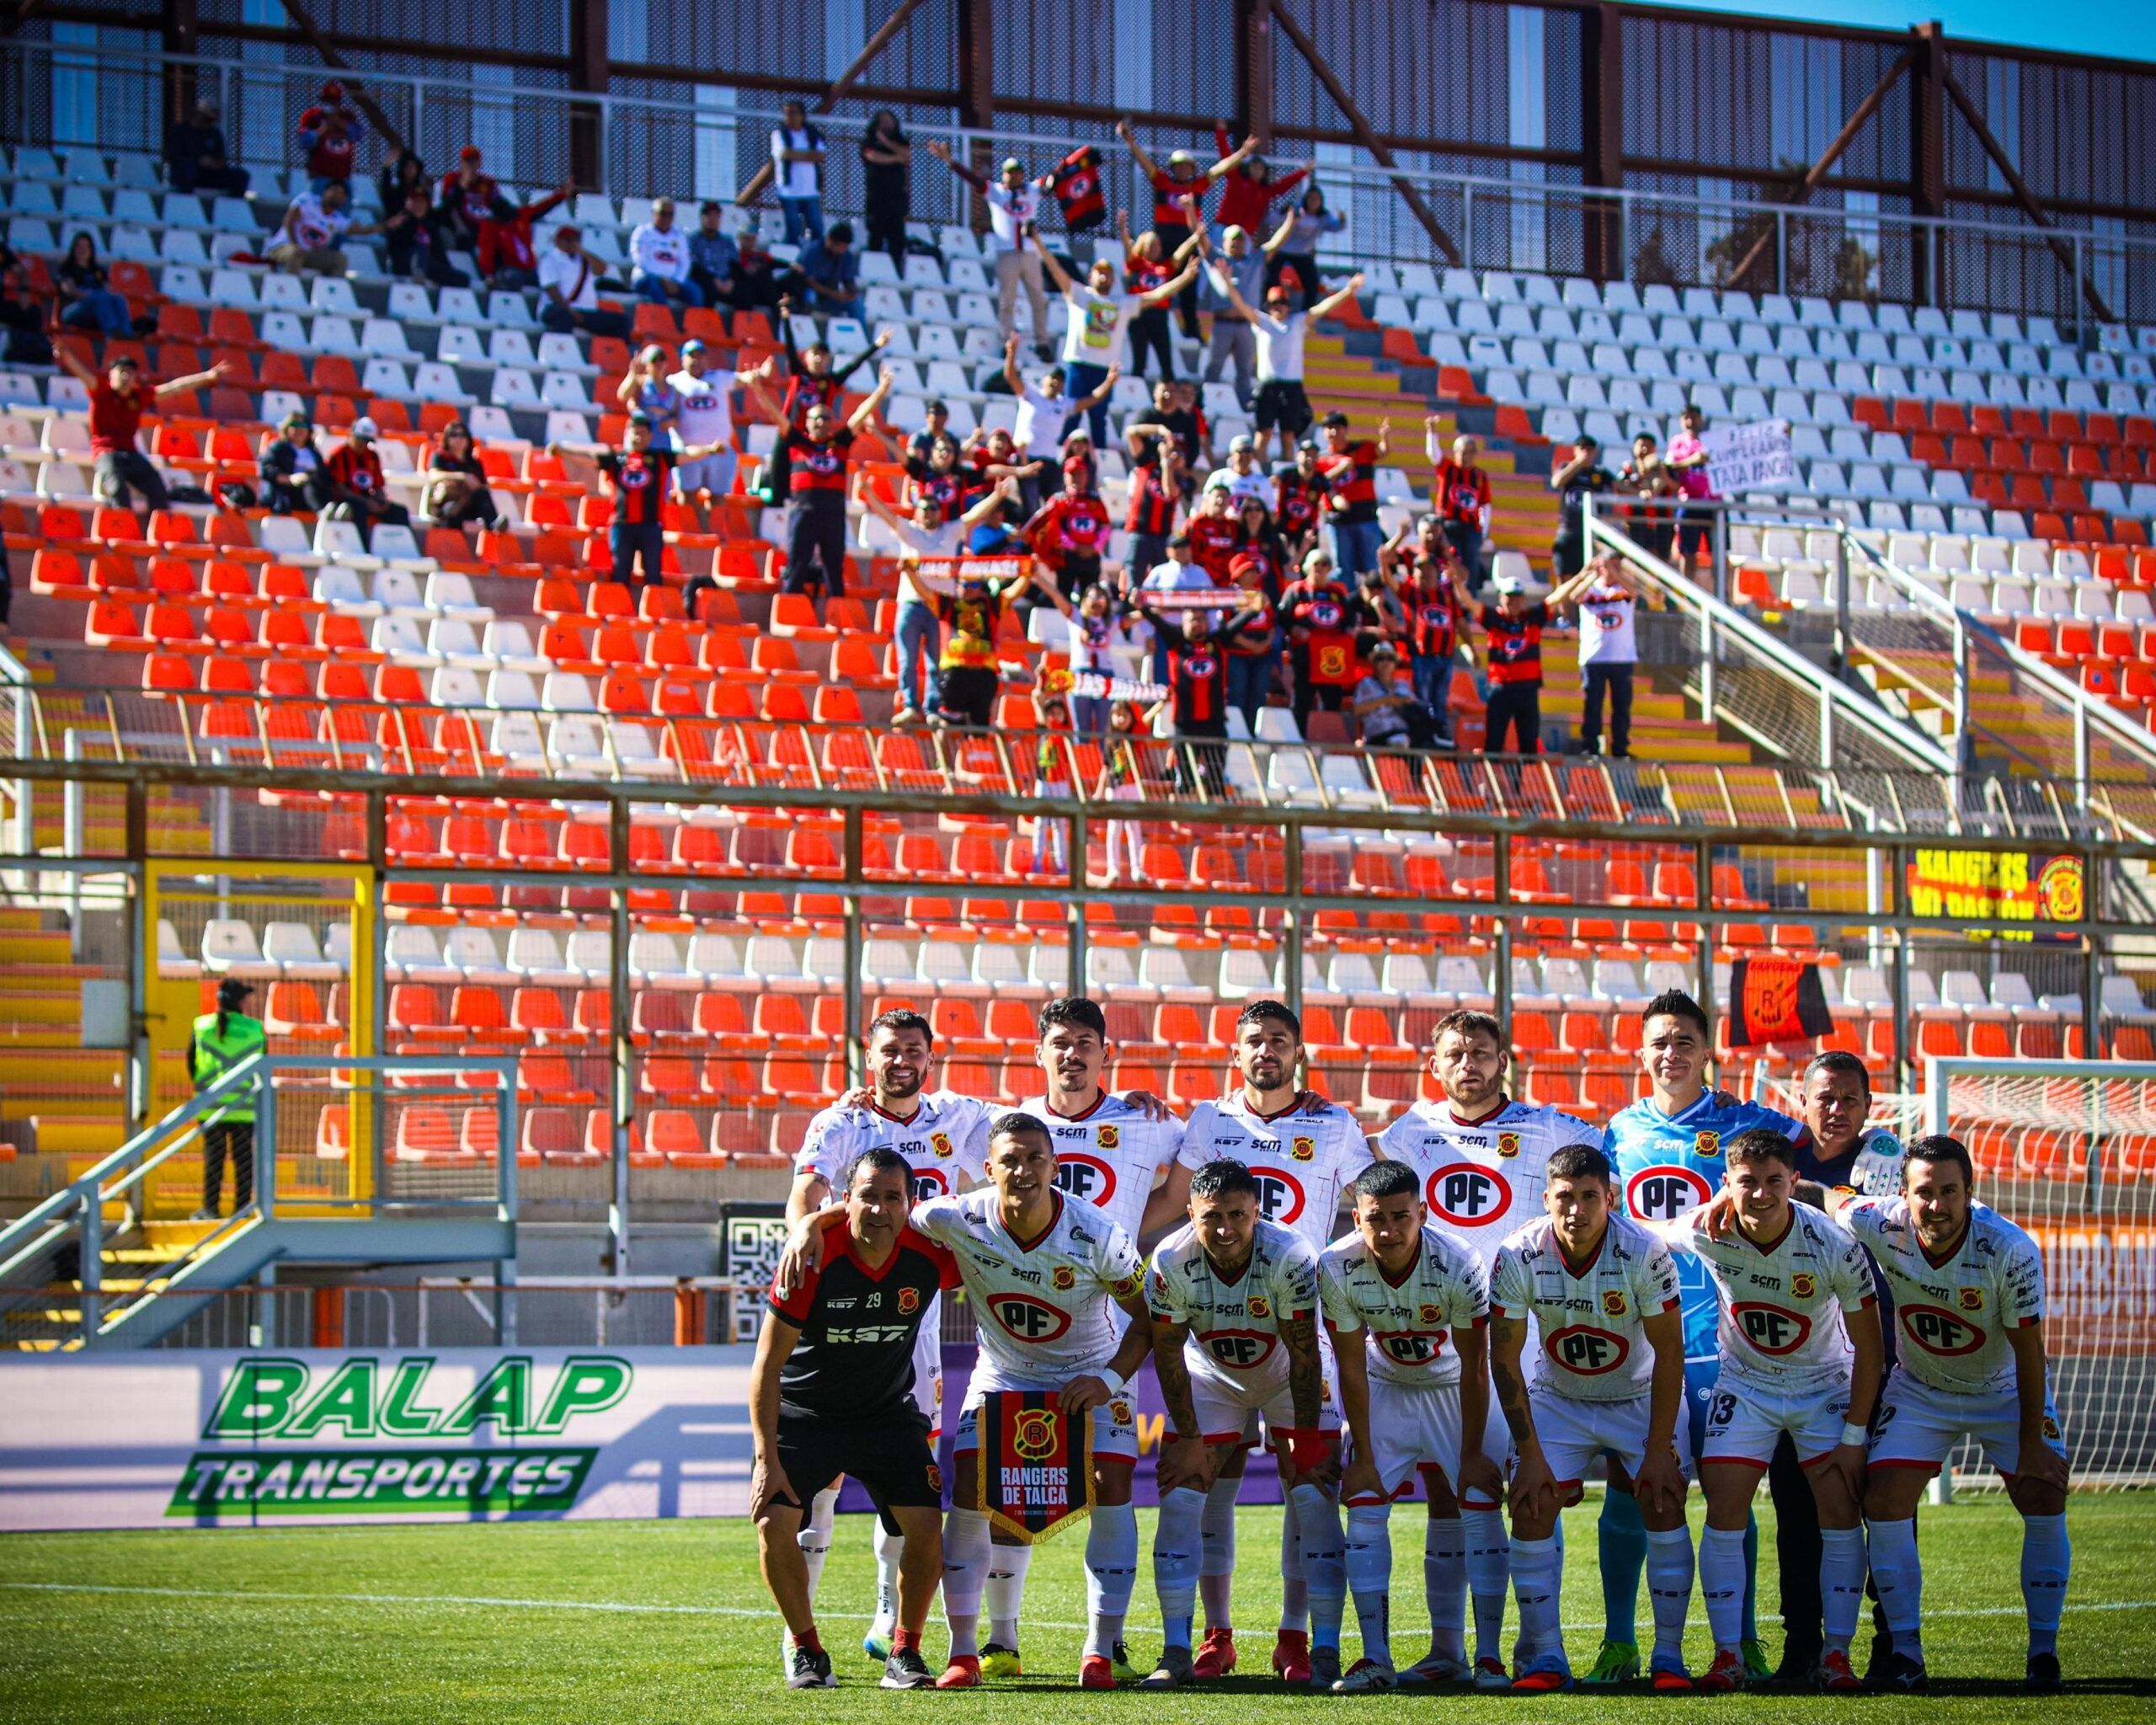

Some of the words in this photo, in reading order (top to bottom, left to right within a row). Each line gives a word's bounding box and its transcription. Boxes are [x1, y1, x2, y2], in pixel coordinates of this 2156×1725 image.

[1056, 1126, 1086, 1139] scm
[1458, 1135, 1487, 1148] scm
[1251, 1140, 1282, 1152] scm
[1255, 1178, 1285, 1220] F
[1445, 1173, 1490, 1215] PF
[1642, 1178, 1688, 1219] PF
[1011, 1268, 1042, 1284] scm
[1750, 1274, 1781, 1290] scm
[827, 1300, 855, 1309] KS7
[866, 1292, 882, 1308] 29
[1566, 1298, 1593, 1313] scm
[1002, 1302, 1049, 1337] PF
[1744, 1311, 1790, 1347] PF
[826, 1326, 909, 1343] KS7
[1915, 1313, 1962, 1348] PF
[1212, 1338, 1256, 1364] PF
[1390, 1337, 1428, 1359] PF
[1564, 1333, 1608, 1369] PF
[201, 1355, 634, 1439] BALAP
[1709, 1394, 1737, 1426] 13
[1028, 1424, 1043, 1443] R
[187, 1456, 583, 1500] TRANSPORTES
[1001, 1467, 1068, 1486] RANGERS
[1002, 1487, 1021, 1505] DE
[1024, 1487, 1068, 1504] TALCA
